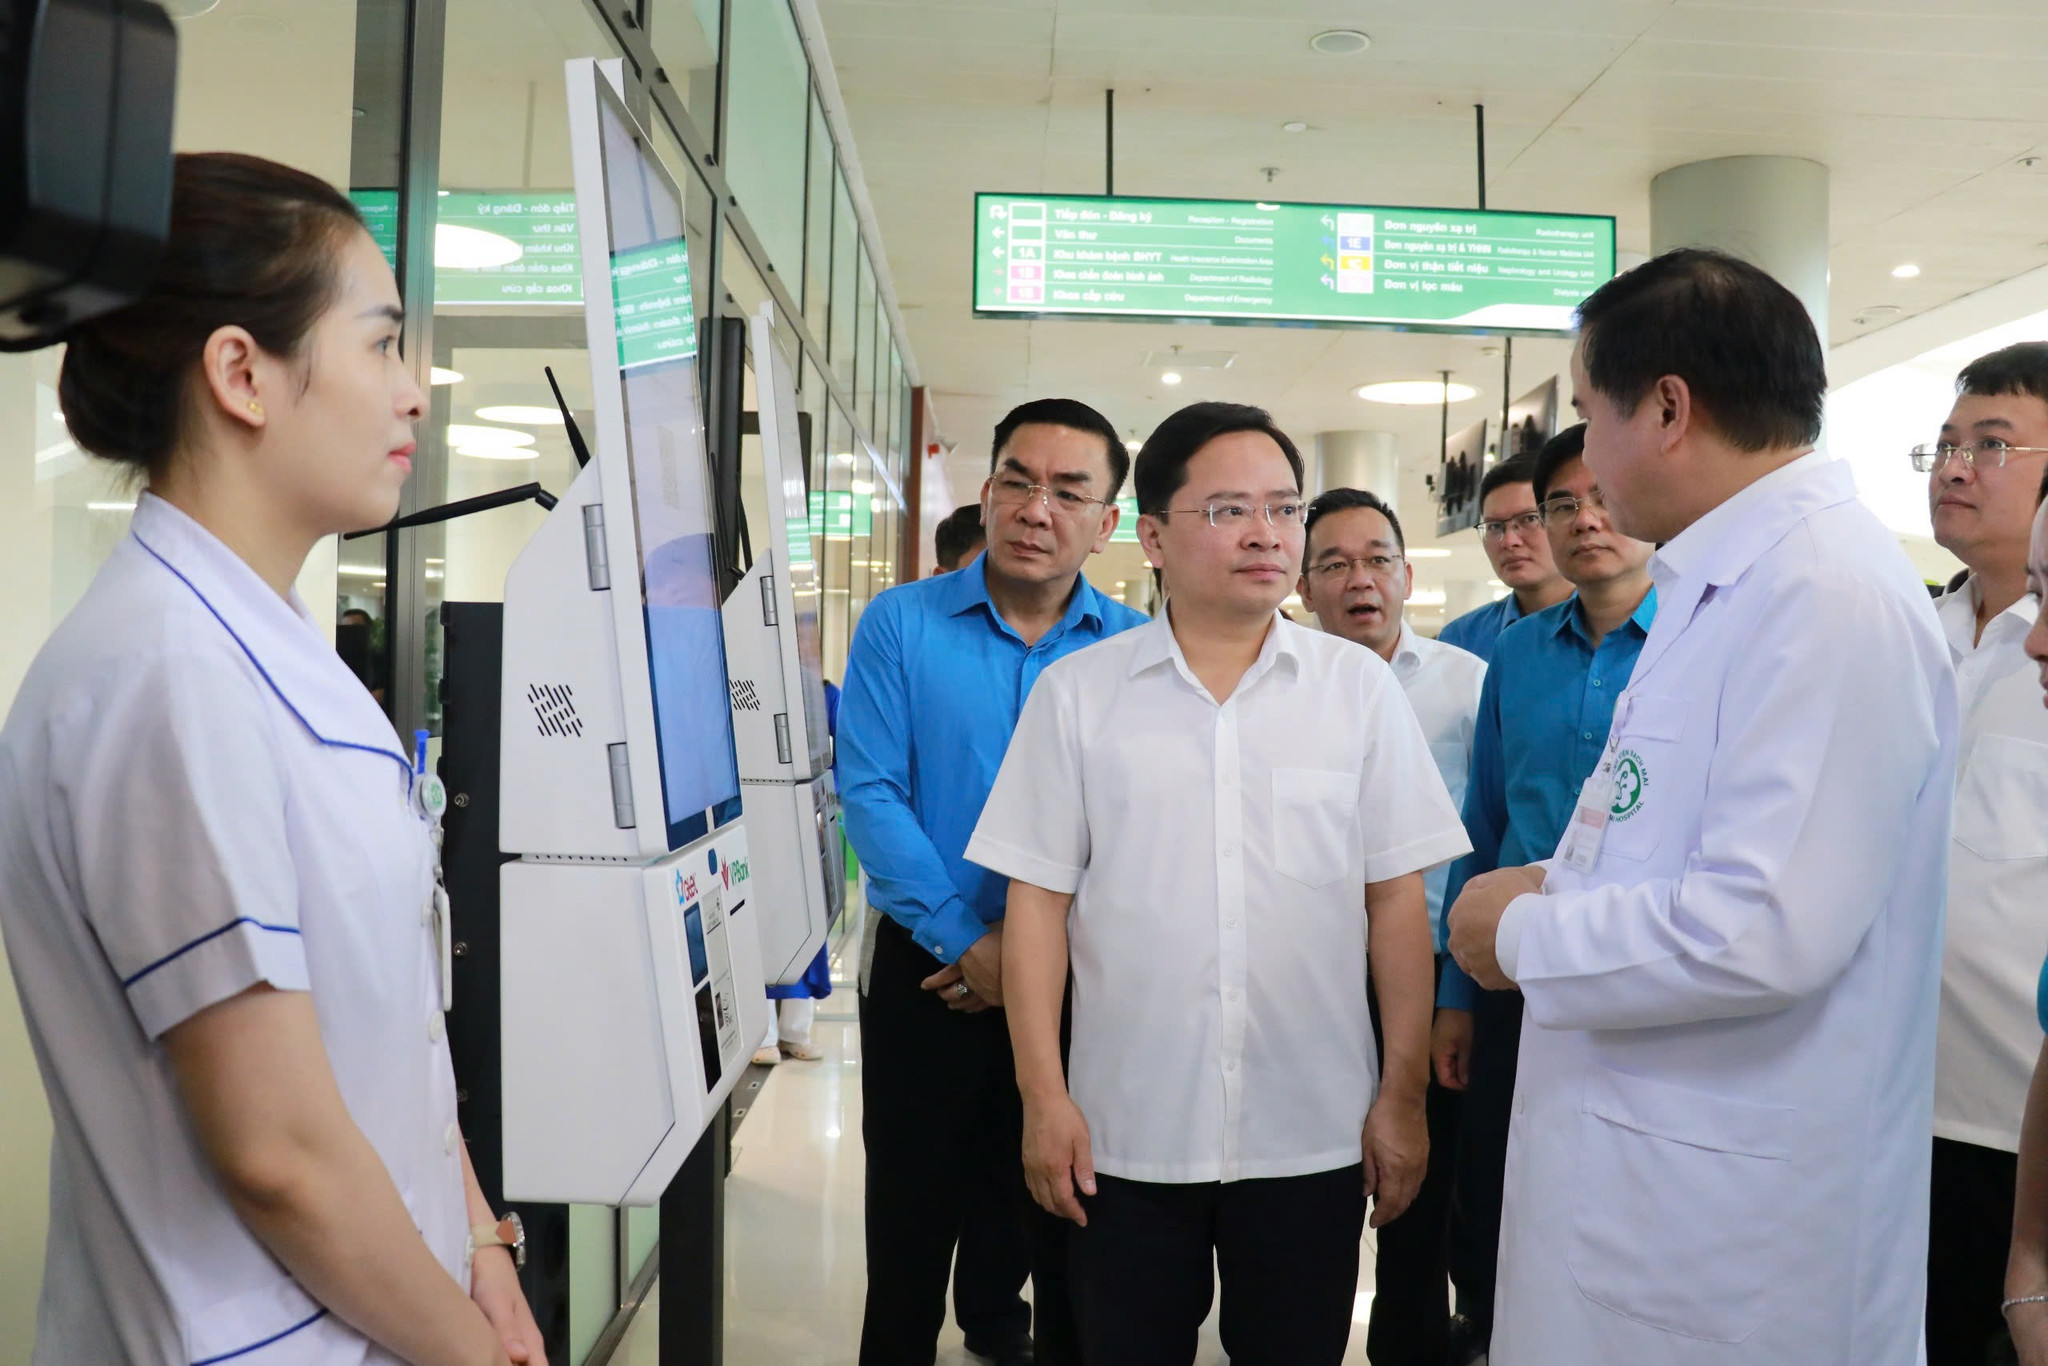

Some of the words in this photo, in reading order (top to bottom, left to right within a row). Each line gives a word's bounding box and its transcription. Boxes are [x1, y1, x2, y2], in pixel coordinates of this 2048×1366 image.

[1641, 768, 1649, 786] MAI
[1615, 801, 1644, 823] HOSPITAL
[729, 856, 750, 887] VPBank
